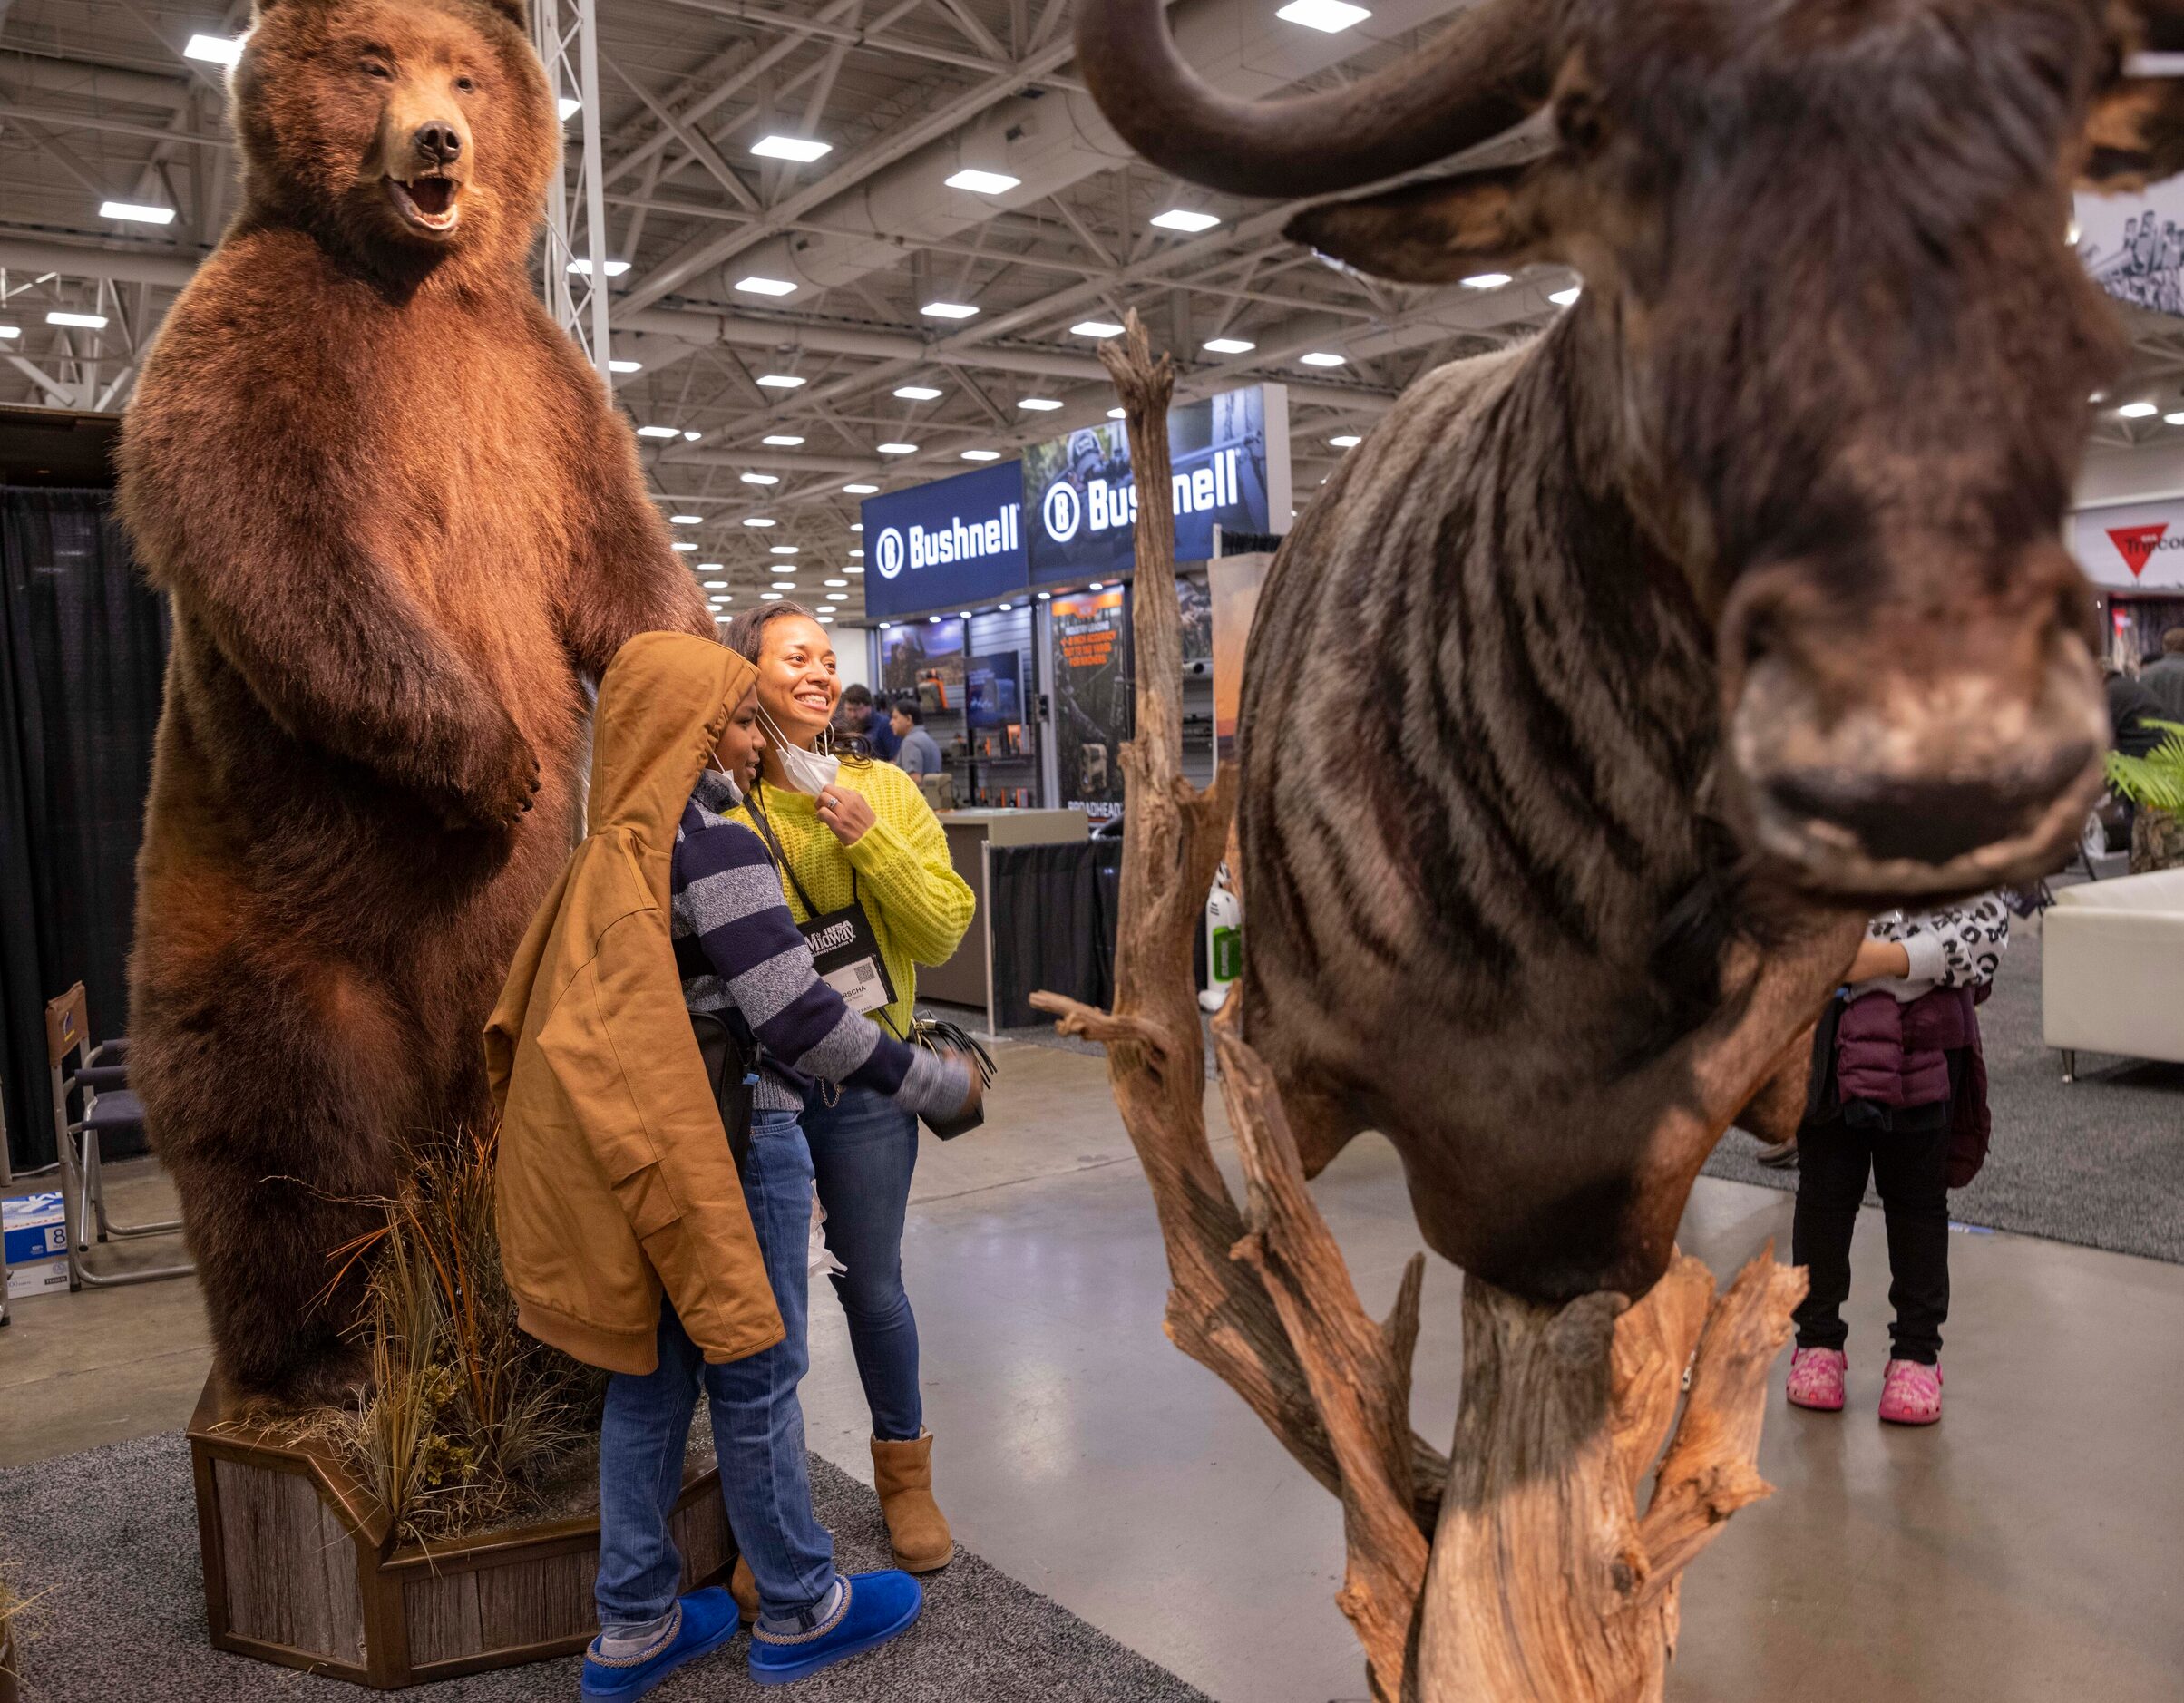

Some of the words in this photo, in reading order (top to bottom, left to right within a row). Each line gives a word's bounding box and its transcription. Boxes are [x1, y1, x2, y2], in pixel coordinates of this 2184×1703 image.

[1088, 448, 1238, 532] Bunell
[909, 502, 1019, 569] Bushnell
[826, 920, 853, 934] USA
[804, 925, 853, 954] Midway
[842, 985, 866, 998] RSCHA
[54, 1228, 65, 1244] 8
